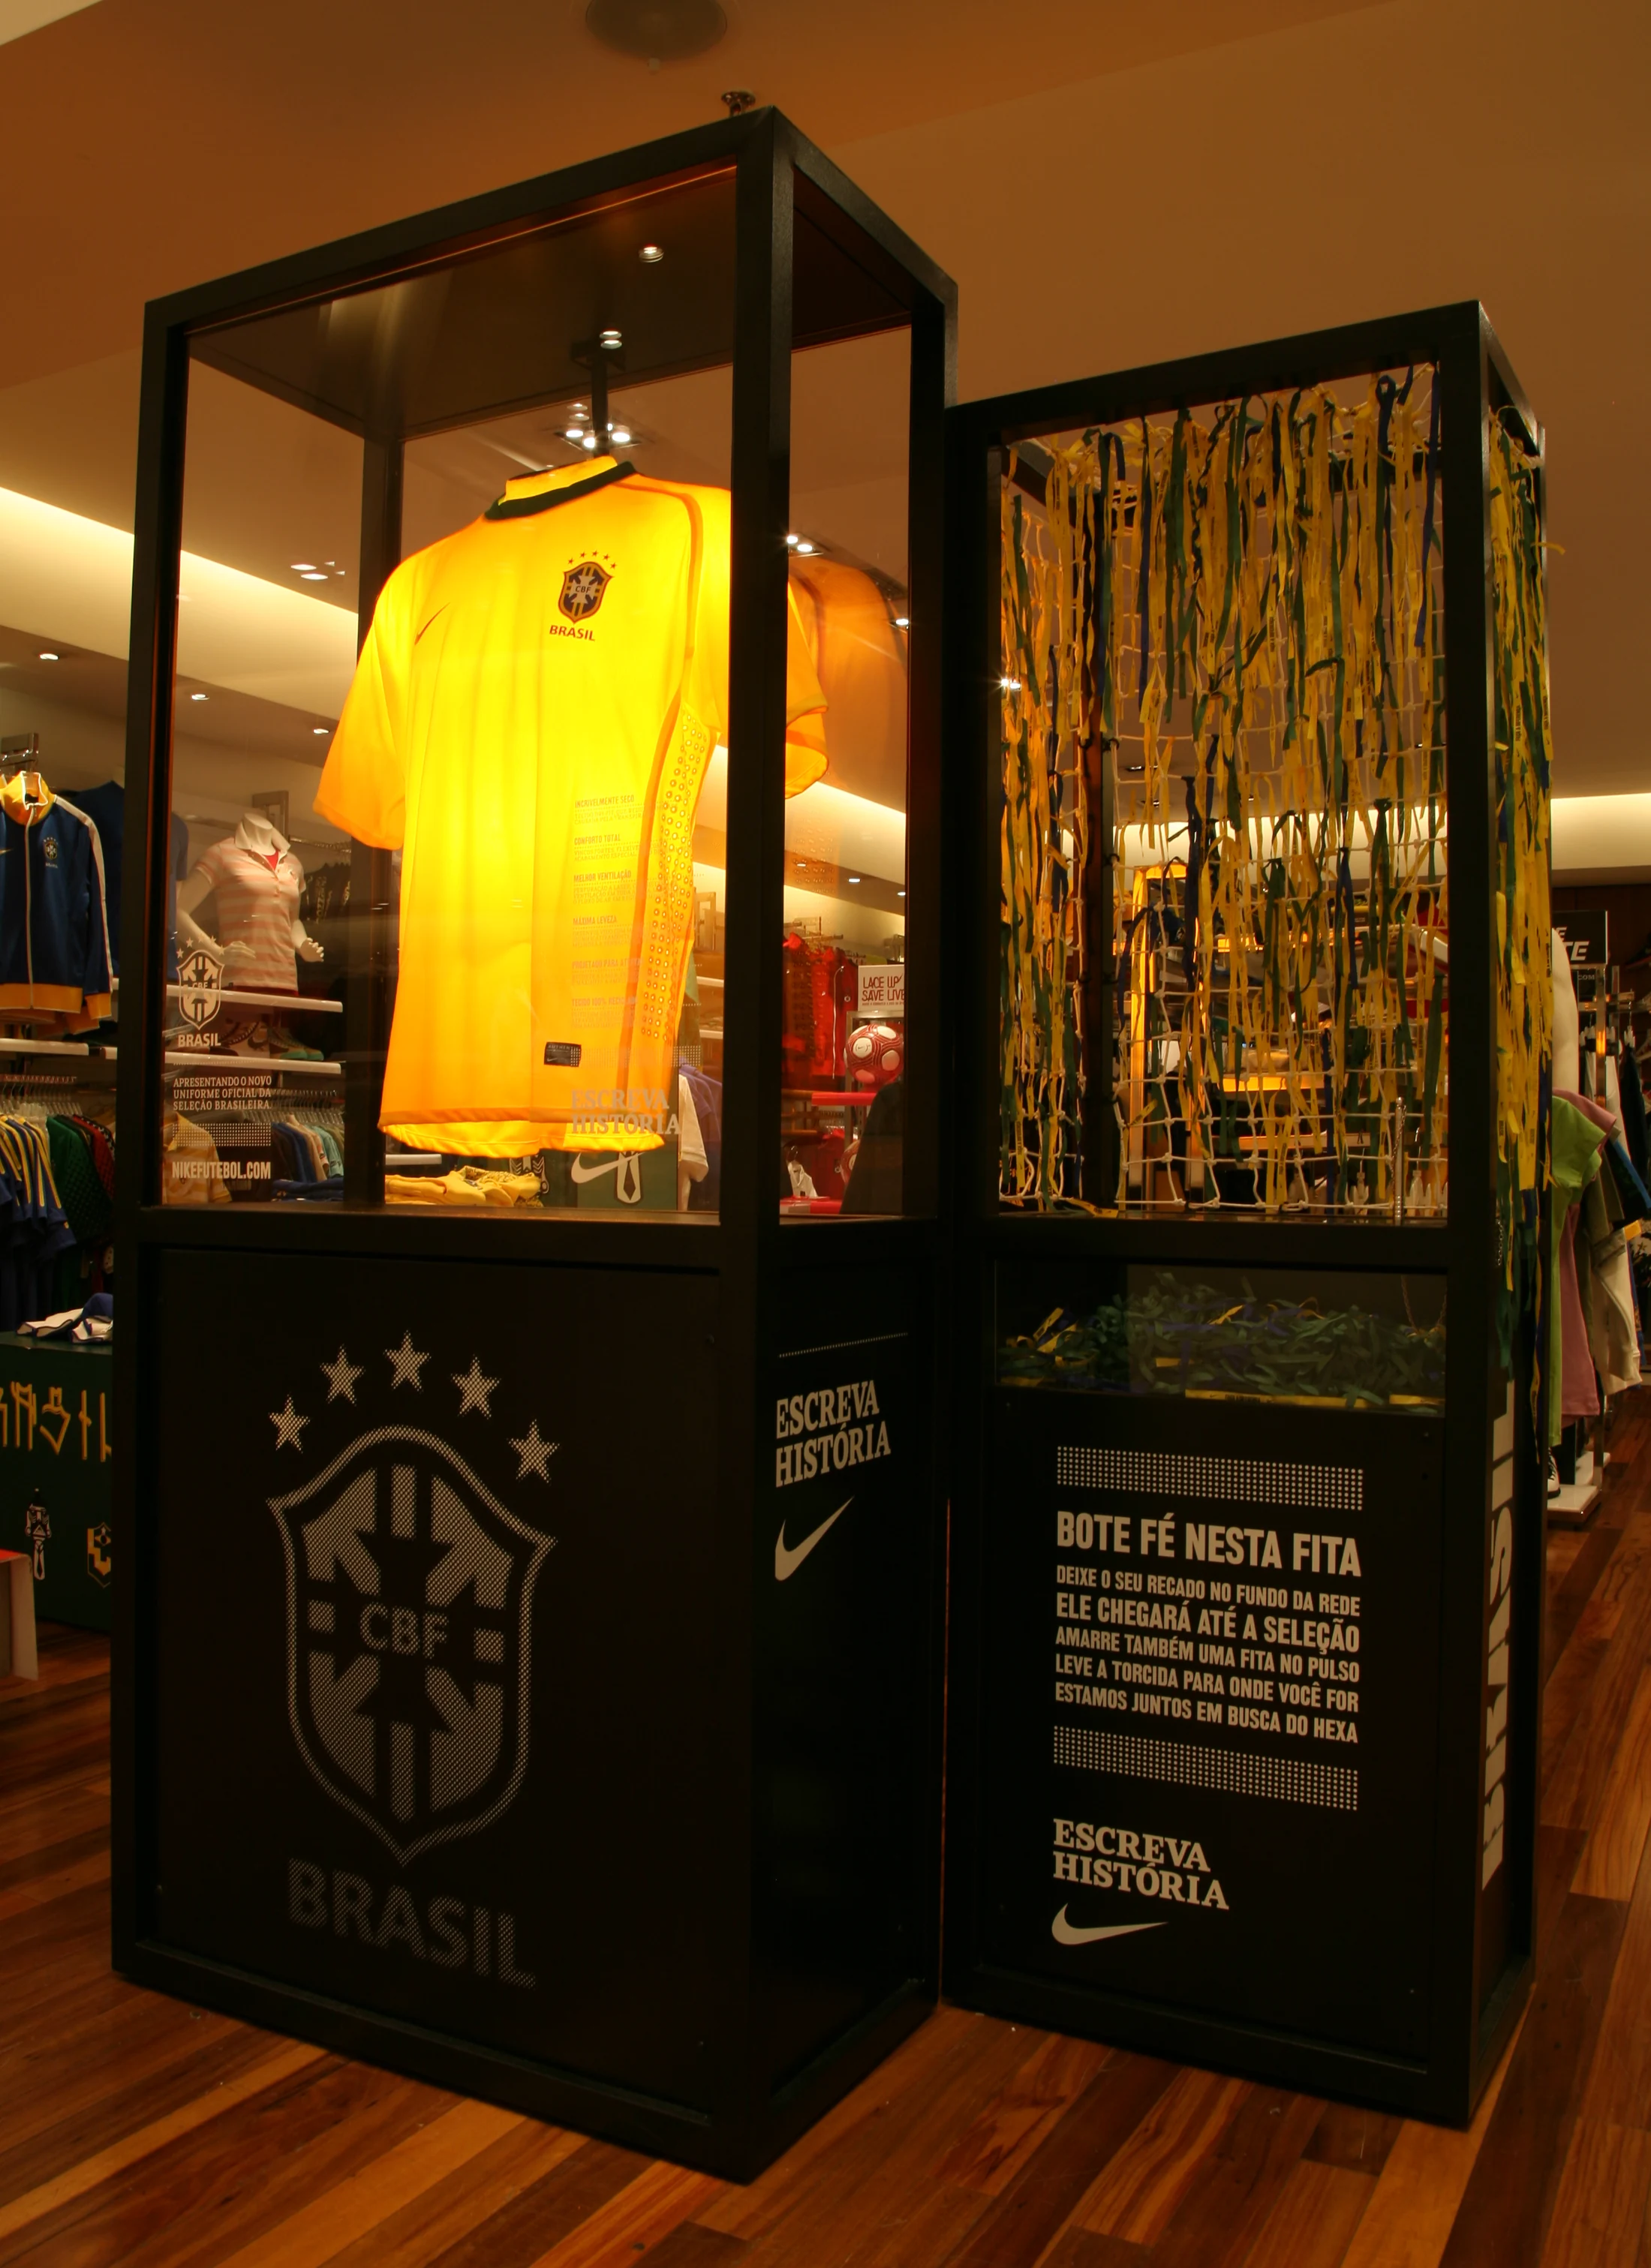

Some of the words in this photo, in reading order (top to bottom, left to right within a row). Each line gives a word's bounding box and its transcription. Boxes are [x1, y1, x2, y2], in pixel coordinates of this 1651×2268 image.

[549, 625, 595, 641] BRASIL
[575, 795, 619, 808] INCRIVELMENTE
[621, 795, 634, 804] SECO
[574, 836, 602, 846] CONFORTO
[604, 834, 621, 843] TOTAL
[573, 873, 597, 882] MELHOR
[597, 870, 632, 881] VENTILAÇÃO
[573, 916, 595, 926] MÁXIMA
[597, 915, 618, 925] LEVEZA
[863, 978, 884, 989] LACE
[887, 974, 903, 988] UP
[862, 990, 885, 1002] SAVE
[178, 1032, 221, 1047] BRASIL
[173, 1077, 239, 1088] APRESENTANDO
[240, 1077, 247, 1086] O
[248, 1076, 272, 1086] NOVO
[173, 1089, 220, 1099] UNIFORME
[221, 1088, 257, 1099] OFICIAL
[259, 1088, 272, 1098] DA
[173, 1099, 212, 1112] SELEÇÃO
[215, 1100, 272, 1110] BRASILEIRA.
[571, 1089, 670, 1110] ESCREVA
[571, 1110, 682, 1135] HISTÓRIA
[172, 1161, 272, 1179] NIKEFUTEBOL.COM
[776, 1380, 880, 1440] ESCREVA
[775, 1420, 892, 1488] HISTÓRIA
[1057, 1511, 1131, 1553] BOTE
[1140, 1512, 1175, 1558] FÉ
[1185, 1522, 1283, 1570] NESTA
[1292, 1533, 1362, 1577] FITA
[1057, 1565, 1097, 1588] DEIXE
[1101, 1570, 1111, 1589] O
[1114, 1571, 1143, 1592] SEU
[1147, 1574, 1205, 1600] RECADO
[1210, 1582, 1231, 1603] NO
[1236, 1584, 1289, 1609] FUNDO
[1293, 1590, 1314, 1612] DA
[1319, 1593, 1361, 1617] REDE
[358, 1603, 450, 1660] CBF
[1057, 1592, 1092, 1621] ELE
[1097, 1597, 1192, 1633] CHEGARÁ
[1197, 1606, 1237, 1639] ATÉ
[1242, 1614, 1258, 1641] A
[1264, 1615, 1360, 1655] SELEÇÃO
[1055, 1626, 1120, 1652] AMARRE
[1124, 1633, 1194, 1661] TAMBÉM
[1198, 1643, 1236, 1667] UMA
[1241, 1648, 1275, 1672] FITA
[1280, 1653, 1303, 1676] NO
[1308, 1657, 1360, 1683] PULSO
[1056, 1654, 1093, 1677] LEVE
[1096, 1659, 1108, 1679] A
[1111, 1660, 1179, 1688] TORCIDA
[1183, 1670, 1225, 1696] PARA
[1229, 1676, 1274, 1702] ONDE
[1278, 1681, 1322, 1708] VOCÊ
[1326, 1688, 1359, 1713] FOR
[1056, 1682, 1127, 1710] ESTAMOS
[1132, 1693, 1192, 1720] JUNTOS
[1196, 1701, 1222, 1724] EM
[1228, 1705, 1281, 1732] BUSCA
[1286, 1714, 1309, 1736] DO
[1313, 1717, 1358, 1744] HEXA
[1053, 1818, 1211, 1873] ESCREVA
[1053, 1851, 1230, 1911] HISTÓRIA
[287, 1857, 538, 1992] BRASIL
